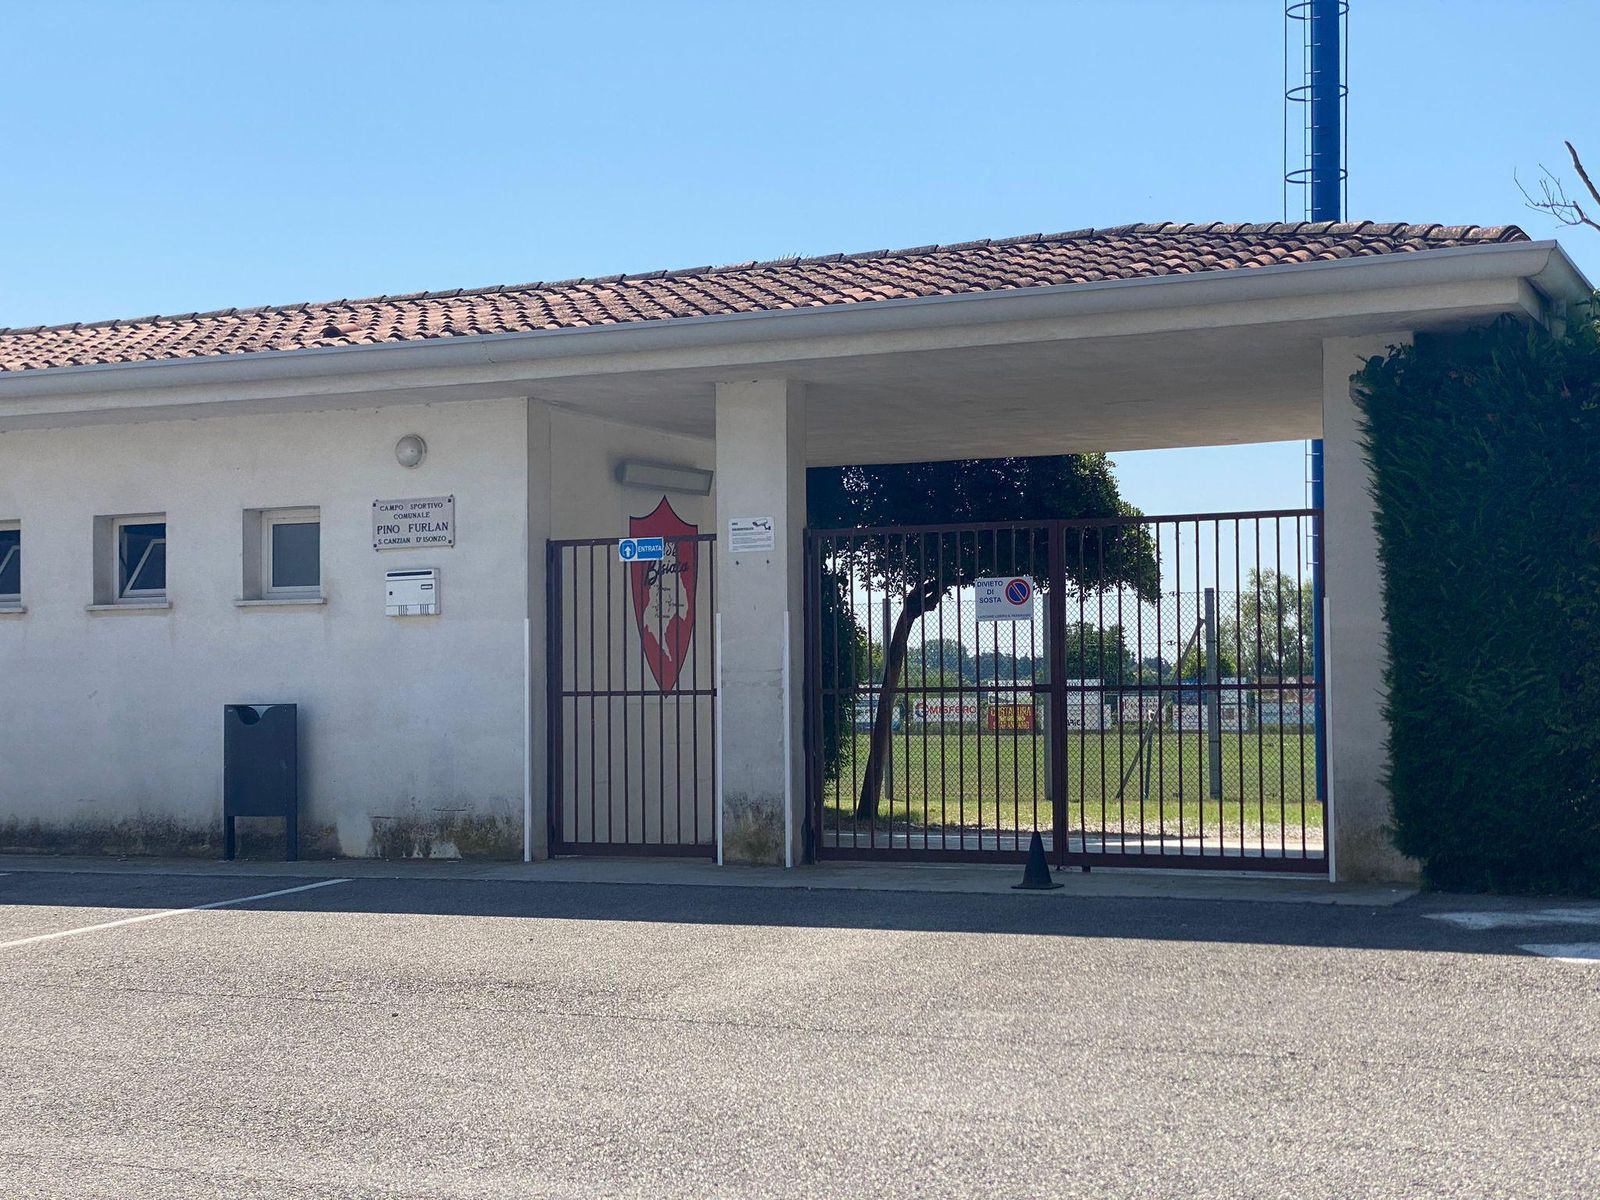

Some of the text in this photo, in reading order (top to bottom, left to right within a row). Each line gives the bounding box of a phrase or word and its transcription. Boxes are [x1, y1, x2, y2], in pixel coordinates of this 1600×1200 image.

[410, 502, 443, 510] SPORTIVO
[377, 522, 449, 535] PINO FURLAN
[638, 545, 662, 553] ENTRATA
